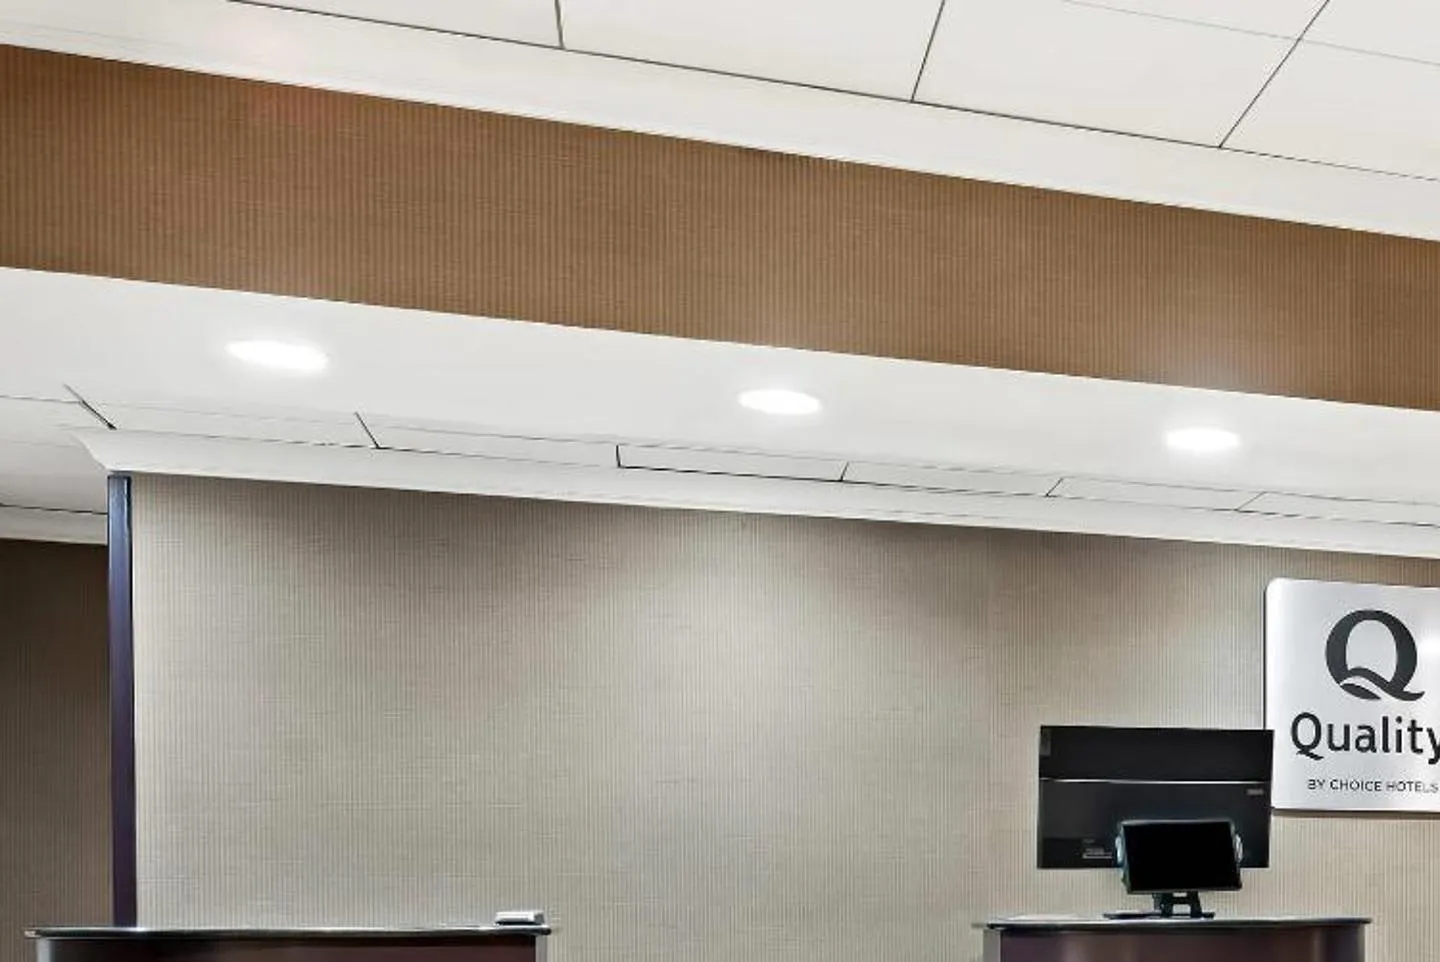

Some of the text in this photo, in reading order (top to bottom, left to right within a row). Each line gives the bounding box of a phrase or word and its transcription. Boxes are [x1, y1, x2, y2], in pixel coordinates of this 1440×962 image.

[1325, 609, 1425, 701] Q
[1307, 779, 1439, 793] BY CHOICE HOTELS
